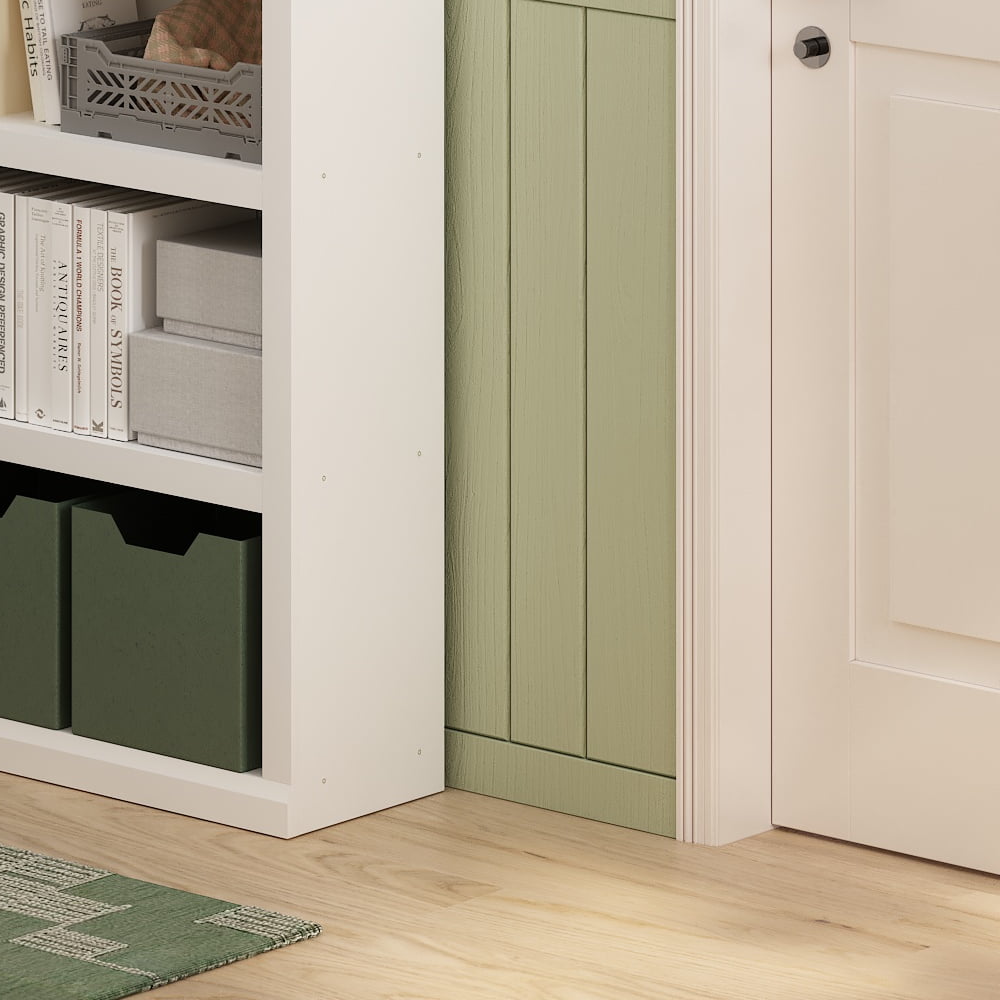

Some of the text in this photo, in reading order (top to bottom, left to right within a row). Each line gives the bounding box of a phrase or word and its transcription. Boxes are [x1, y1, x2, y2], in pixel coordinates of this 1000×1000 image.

[39, 13, 45, 24] TO
[82, 0, 102, 8] EATING
[24, 17, 38, 77] Habits
[40, 27, 48, 46] TAIL
[43, 48, 53, 81] EATING
[111, 267, 123, 313] BOOK
[56, 260, 68, 372] ANTIQUAIRES
[111, 315, 116, 326] OF
[111, 329, 123, 409] SYMBOLS
